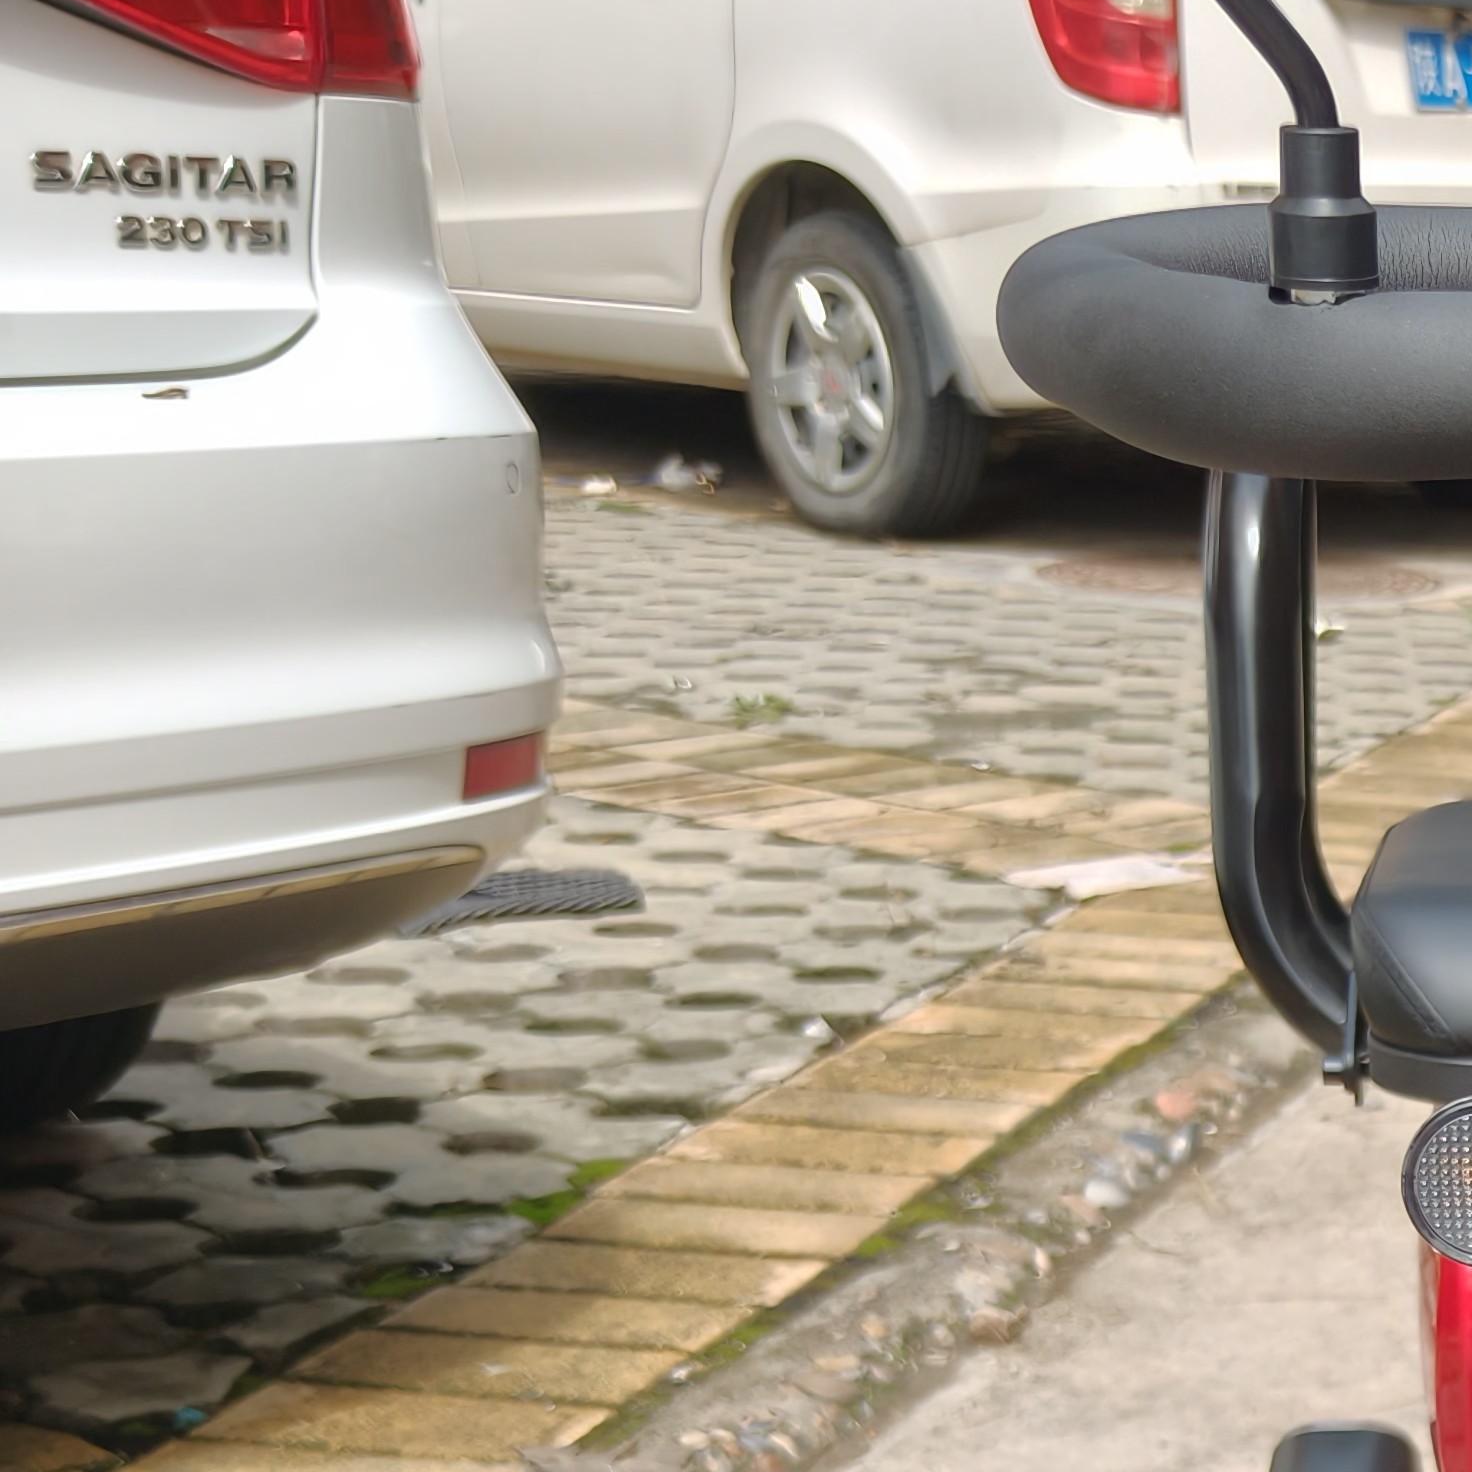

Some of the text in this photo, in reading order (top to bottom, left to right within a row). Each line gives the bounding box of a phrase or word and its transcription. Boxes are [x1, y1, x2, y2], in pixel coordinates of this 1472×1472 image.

[30, 150, 297, 203] SAGITAR
[115, 215, 291, 252] 230 TSI
